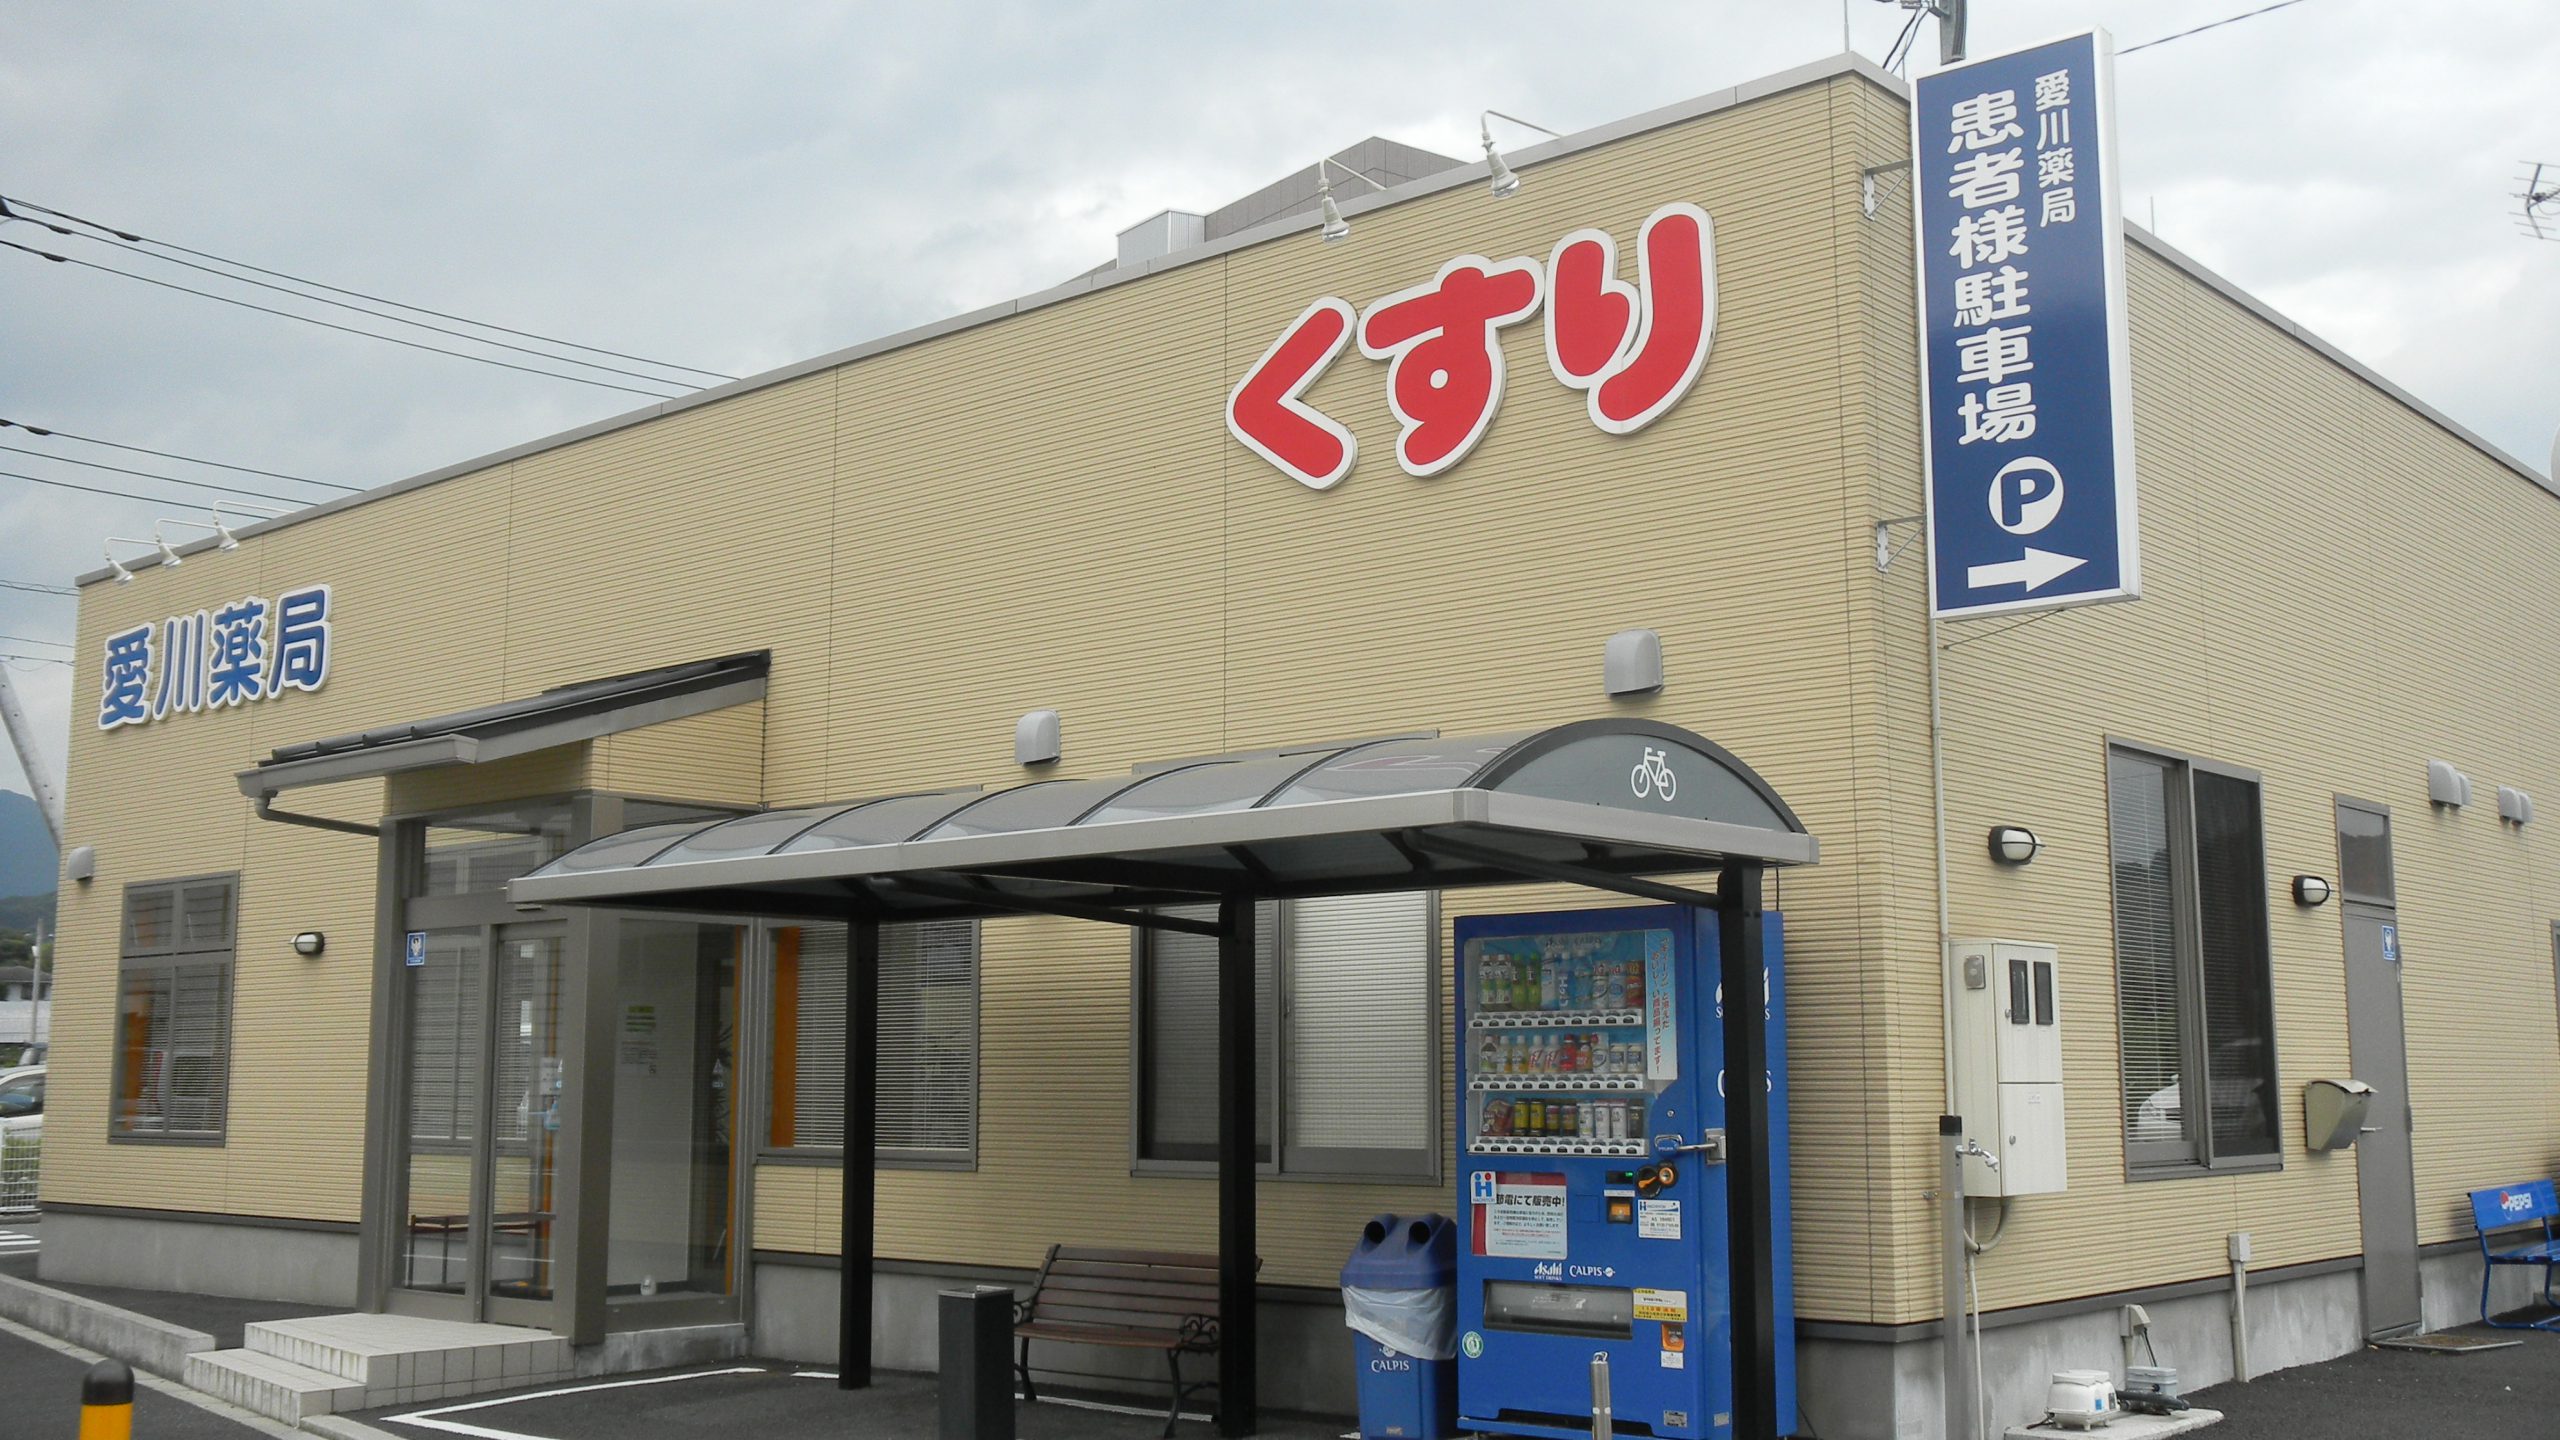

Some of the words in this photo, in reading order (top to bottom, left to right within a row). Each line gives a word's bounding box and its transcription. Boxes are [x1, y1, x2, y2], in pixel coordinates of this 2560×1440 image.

[2034, 68, 2076, 228] 愛川薬局
[1947, 89, 2037, 446] 患者様駐車場
[1226, 202, 1717, 490] くすり
[1999, 467, 2056, 528] P
[99, 585, 330, 729] 愛川薬局
[2509, 1192, 2533, 1212] PEPSI
[1534, 1261, 1563, 1276] Asahi
[1569, 1265, 1603, 1277] CALPIS
[1371, 1359, 1410, 1373] CALPIS
